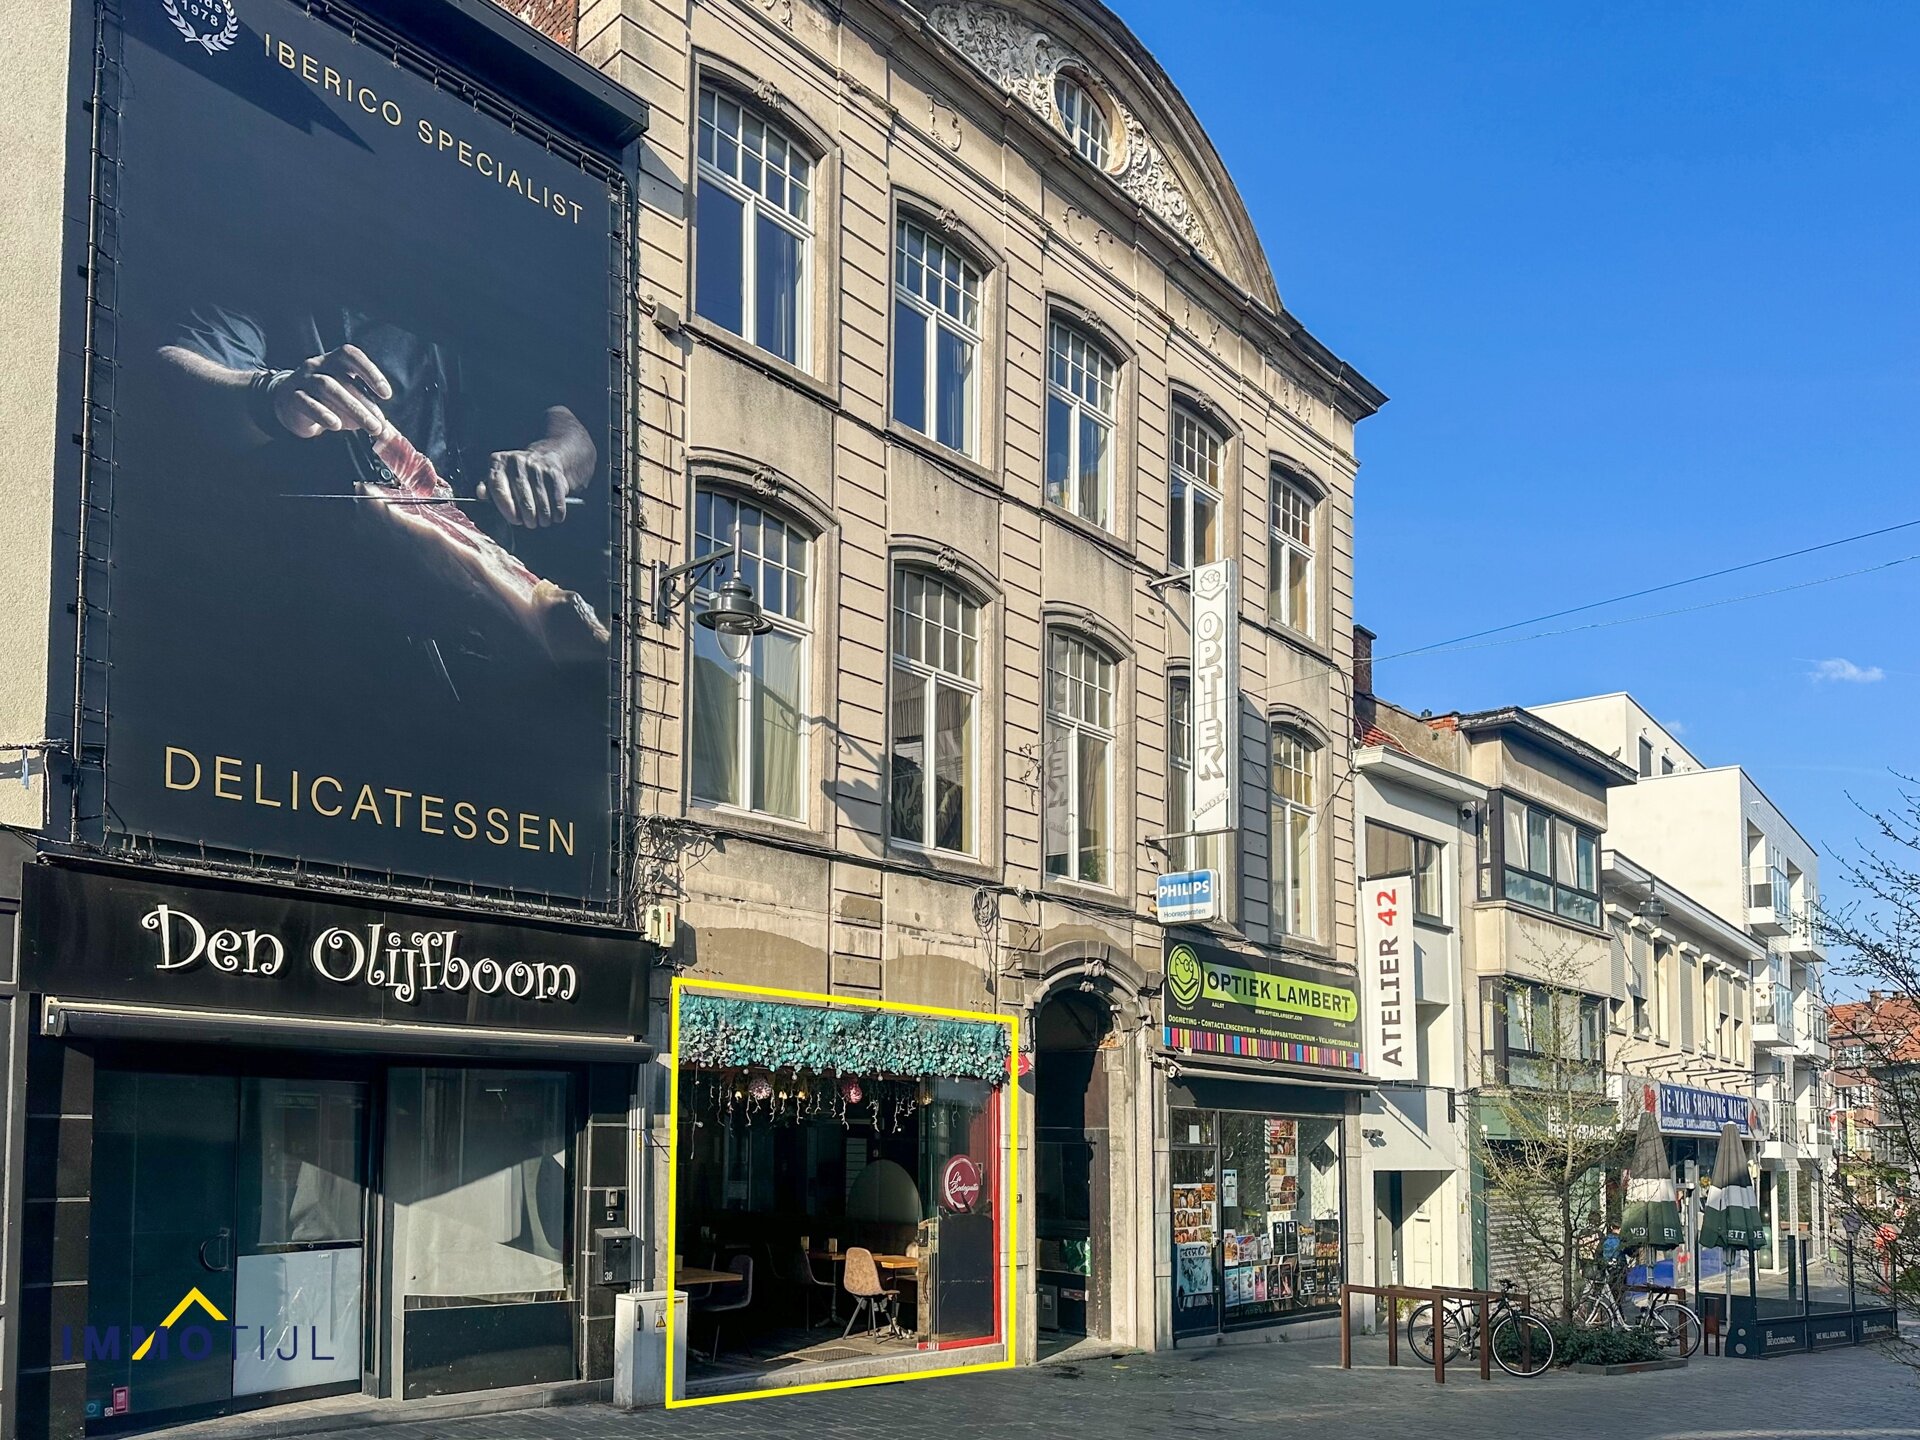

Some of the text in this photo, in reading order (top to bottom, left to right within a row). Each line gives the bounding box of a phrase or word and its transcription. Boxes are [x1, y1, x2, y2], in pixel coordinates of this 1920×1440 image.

[181, 0, 218, 27] 1978
[264, 33, 583, 225] IBERICO SPECIALIST
[1196, 611, 1224, 781] OPTIEK
[164, 745, 576, 857] DELICATESSEN
[1159, 880, 1210, 899] PHILIPS
[141, 904, 578, 1003] Den Olijfboom
[1377, 888, 1402, 1067] ATELIER 42
[1207, 971, 1351, 1014] OPTIEK LAMBERT
[1660, 1088, 1748, 1121] YE-YAO SHOPPING MARKT
[604, 1271, 613, 1281] 38
